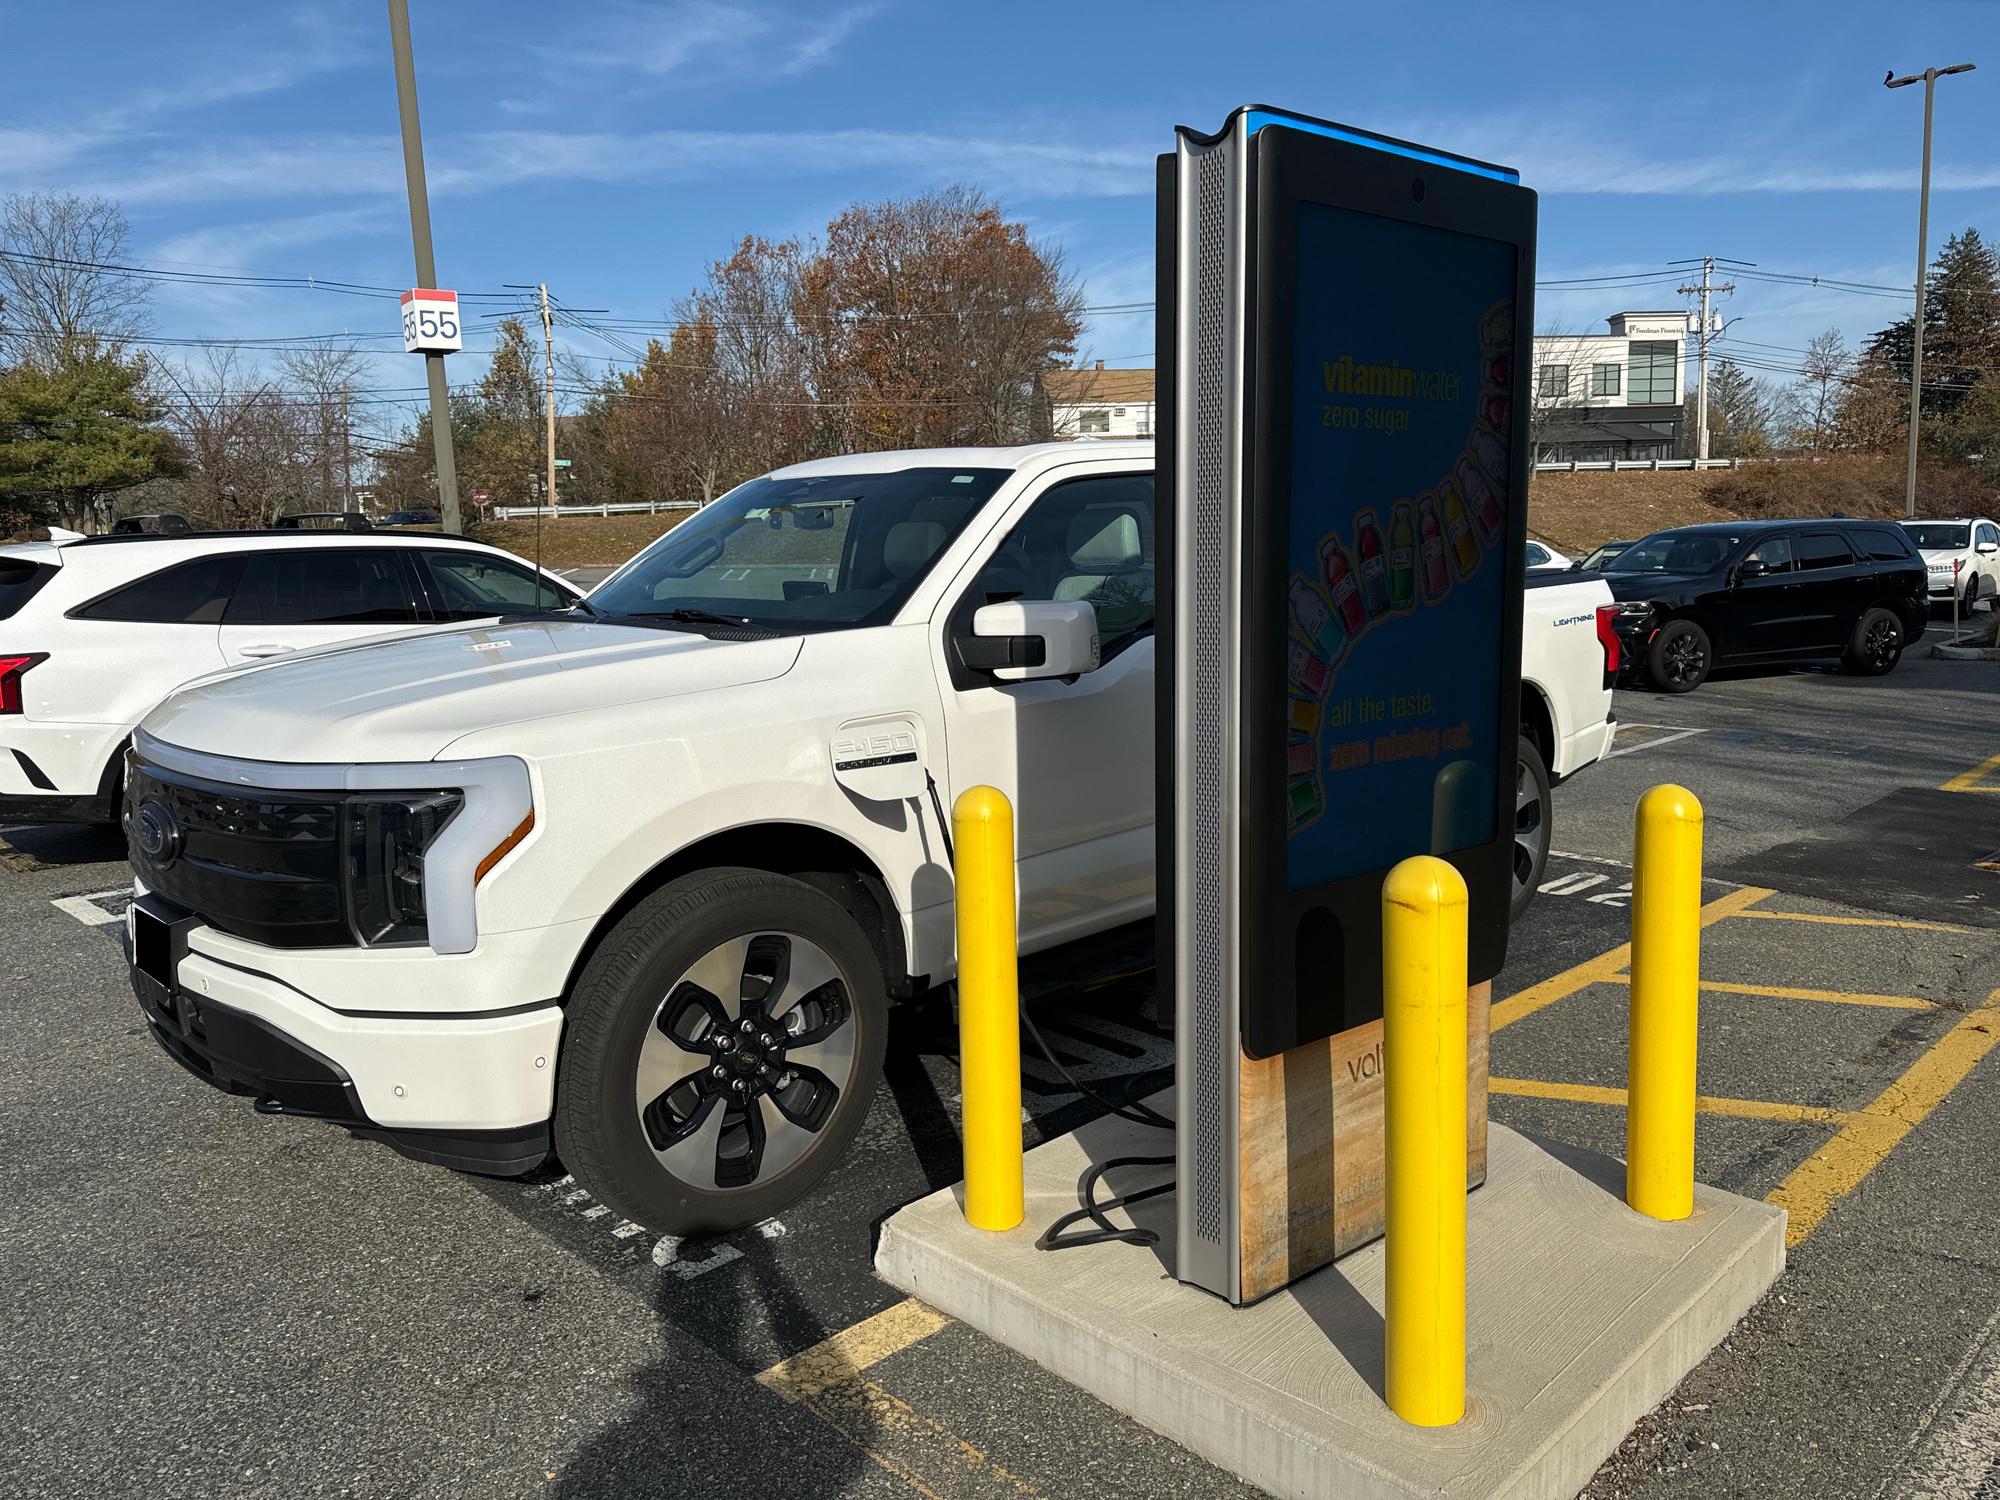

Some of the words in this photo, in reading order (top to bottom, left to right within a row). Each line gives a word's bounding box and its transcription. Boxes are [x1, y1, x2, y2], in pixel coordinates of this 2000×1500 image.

[403, 310, 417, 343] 55
[419, 309, 458, 339] 55
[1322, 353, 1463, 401] vitaminwater
[1321, 403, 1360, 429] zero
[1364, 406, 1412, 437] sugar
[1553, 614, 1594, 626] LIGHTNING
[1331, 697, 1352, 727] all
[1357, 696, 1385, 724] the
[1391, 689, 1437, 718] taste,
[1328, 737, 1369, 772] zero
[1373, 725, 1441, 764] missing
[1347, 1042, 1384, 1083] vol
